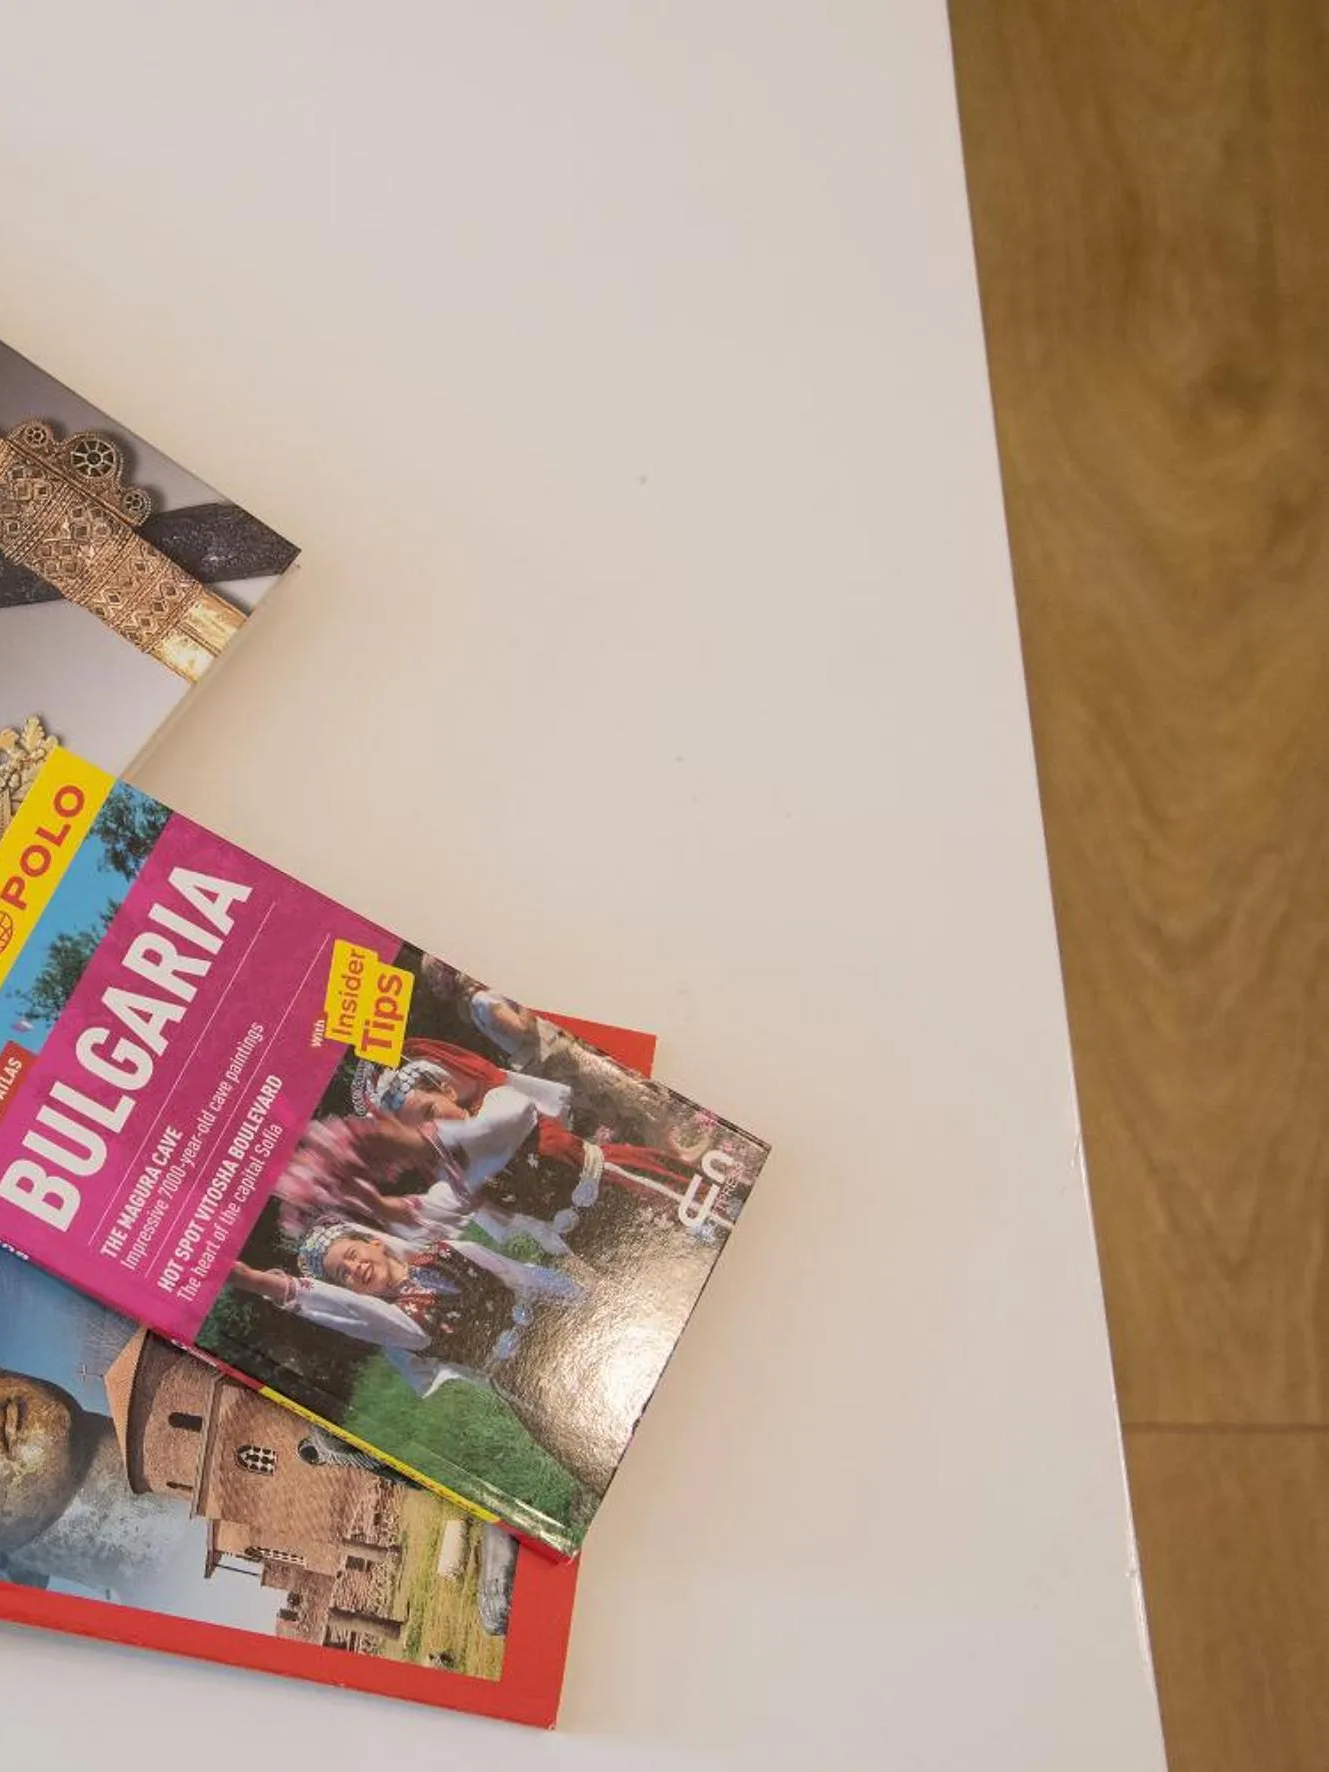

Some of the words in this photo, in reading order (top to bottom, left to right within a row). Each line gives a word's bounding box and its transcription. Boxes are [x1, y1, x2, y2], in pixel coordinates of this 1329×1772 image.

[0, 784, 86, 912] POLO
[331, 948, 367, 1036] Insider
[361, 973, 404, 1052] Tips
[120, 1199, 170, 1271] Impressive
[156, 1109, 217, 1202] 7000-year-old
[208, 1080, 233, 1112] cave
[224, 1021, 265, 1085] paintings
[254, 1123, 283, 1158] Sofia
[100, 1226, 128, 1260] THE
[115, 1166, 162, 1231] MAGURA
[151, 1125, 183, 1167] CAVE
[157, 1258, 184, 1293] HOT
[174, 1218, 206, 1261] SPOT
[194, 1159, 240, 1222] VITOSHA
[227, 1074, 284, 1161] BOULEVARD
[232, 1154, 267, 1204] capital
[211, 1221, 231, 1244] of
[219, 1201, 242, 1226] the
[176, 1276, 202, 1303] The
[189, 1240, 221, 1278] heart
